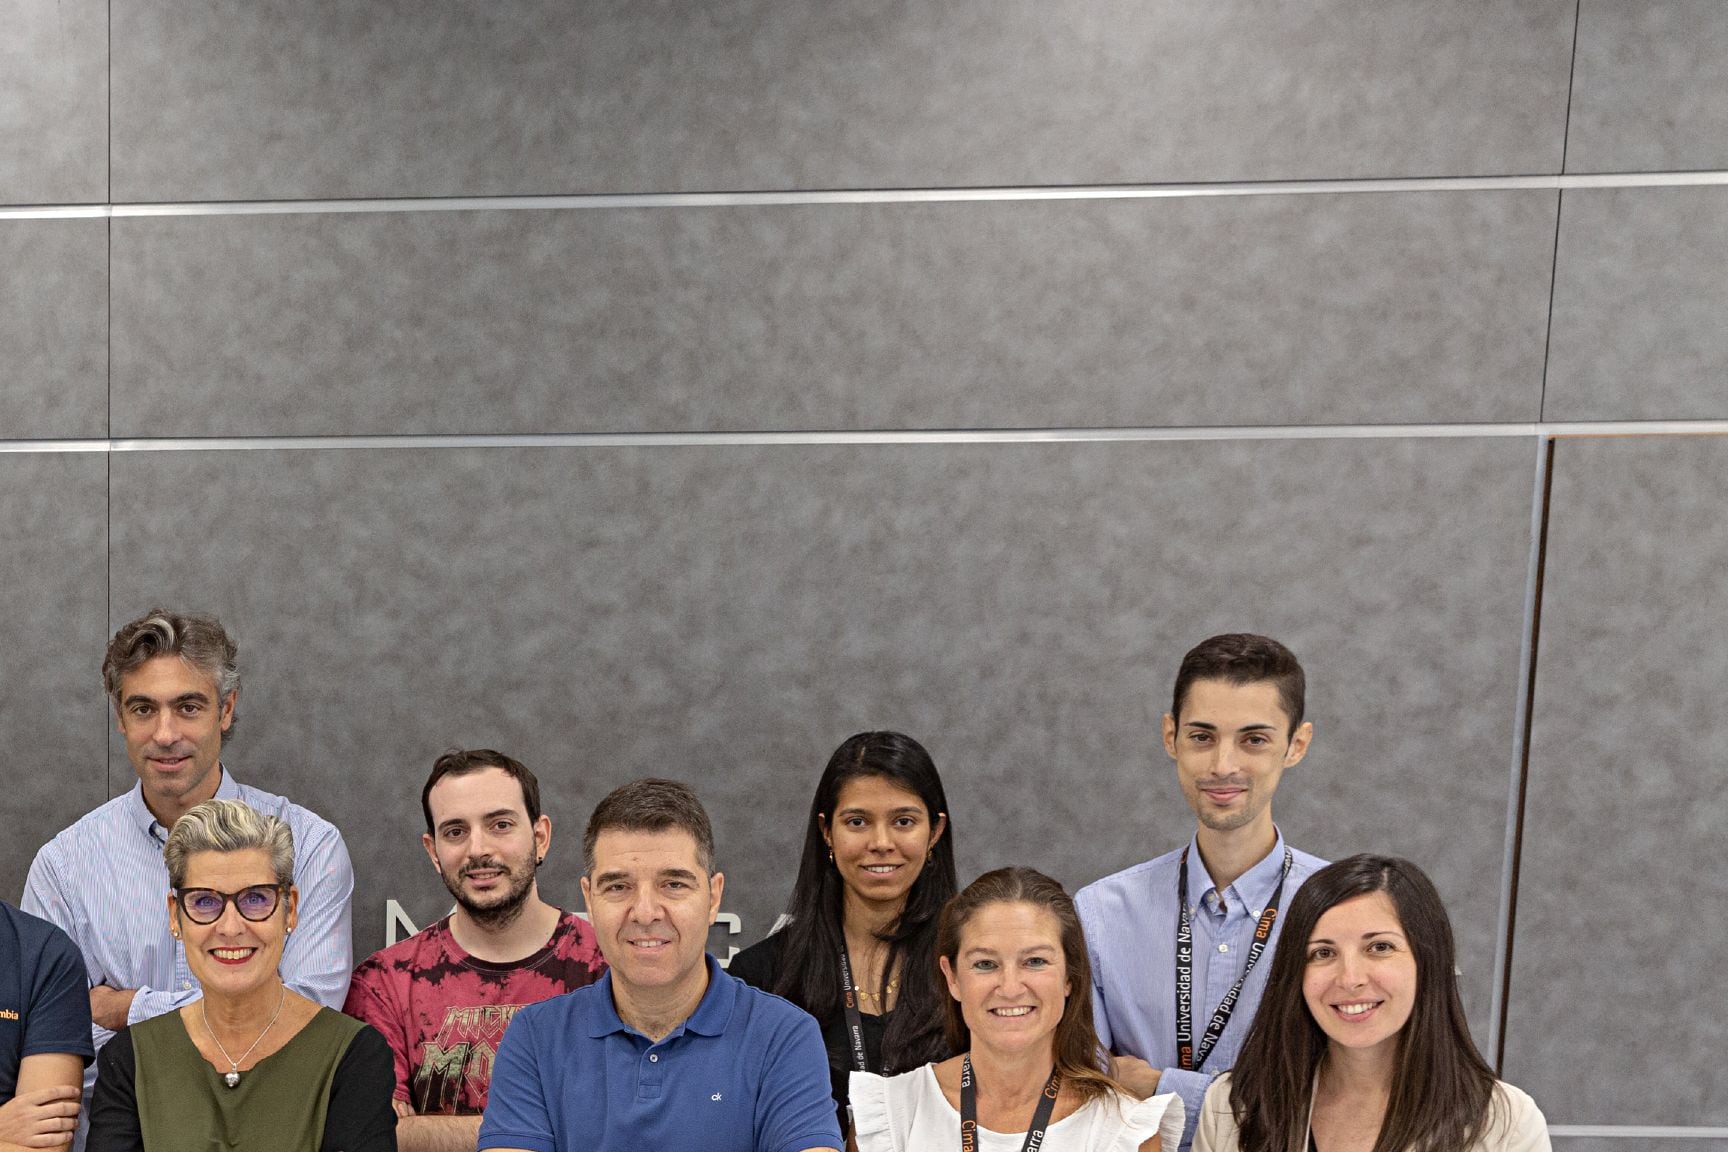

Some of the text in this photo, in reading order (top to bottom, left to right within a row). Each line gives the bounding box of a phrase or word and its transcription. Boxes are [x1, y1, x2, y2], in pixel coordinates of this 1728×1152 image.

[1256, 908, 1277, 939] Cima
[1177, 947, 1191, 962] de
[1177, 967, 1191, 1041] Universidad
[1209, 1014, 1225, 1031] de
[852, 1025, 863, 1051] Navarra
[856, 1050, 865, 1060] de
[961, 1120, 976, 1152] Cima
